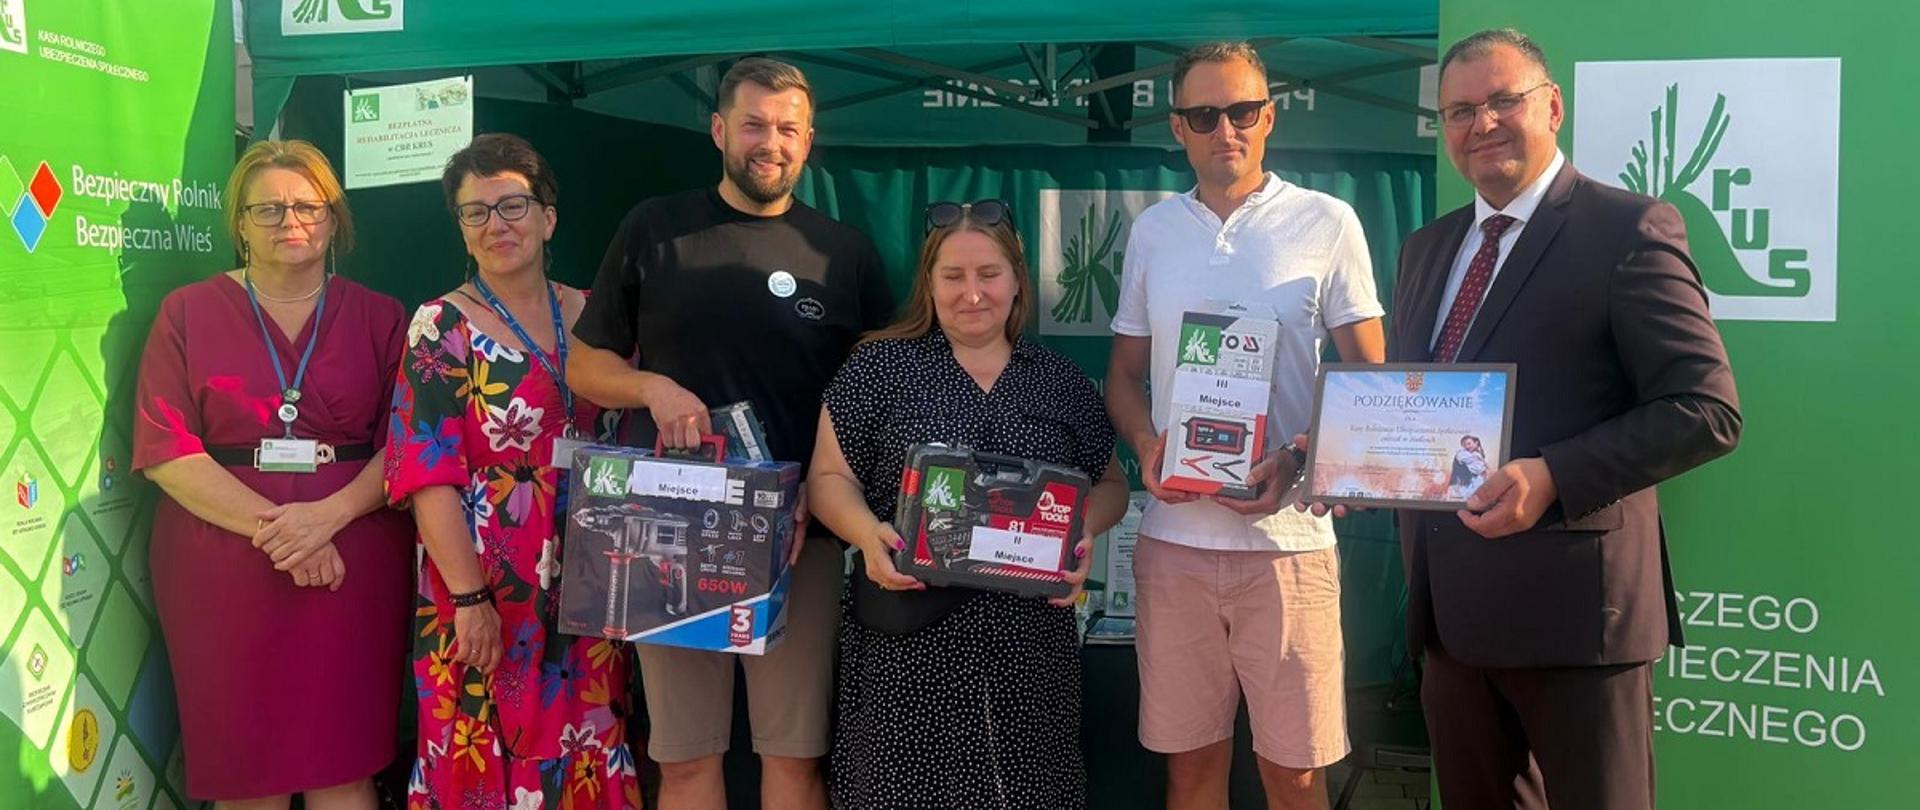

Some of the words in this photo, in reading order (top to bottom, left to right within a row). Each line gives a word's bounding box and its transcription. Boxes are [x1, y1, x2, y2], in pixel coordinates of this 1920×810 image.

[38, 29, 60, 45] KASA
[72, 164, 170, 211] Bezpieczny
[173, 178, 222, 209] Rolnik
[76, 215, 172, 255] Bezpieczna
[175, 224, 213, 252] Wieś
[1216, 379, 1228, 388] III
[1199, 394, 1241, 408] Miejsce
[1354, 394, 1473, 410] PODZIĘKOWANIE
[658, 483, 699, 496] Miejsce
[1053, 504, 1072, 514] TOP
[1040, 511, 1070, 524] TOOLS
[1008, 520, 1025, 533] 81
[1014, 536, 1021, 545] II
[995, 550, 1034, 564] Miejsce
[697, 578, 748, 594] 650W
[731, 608, 751, 632] 3
